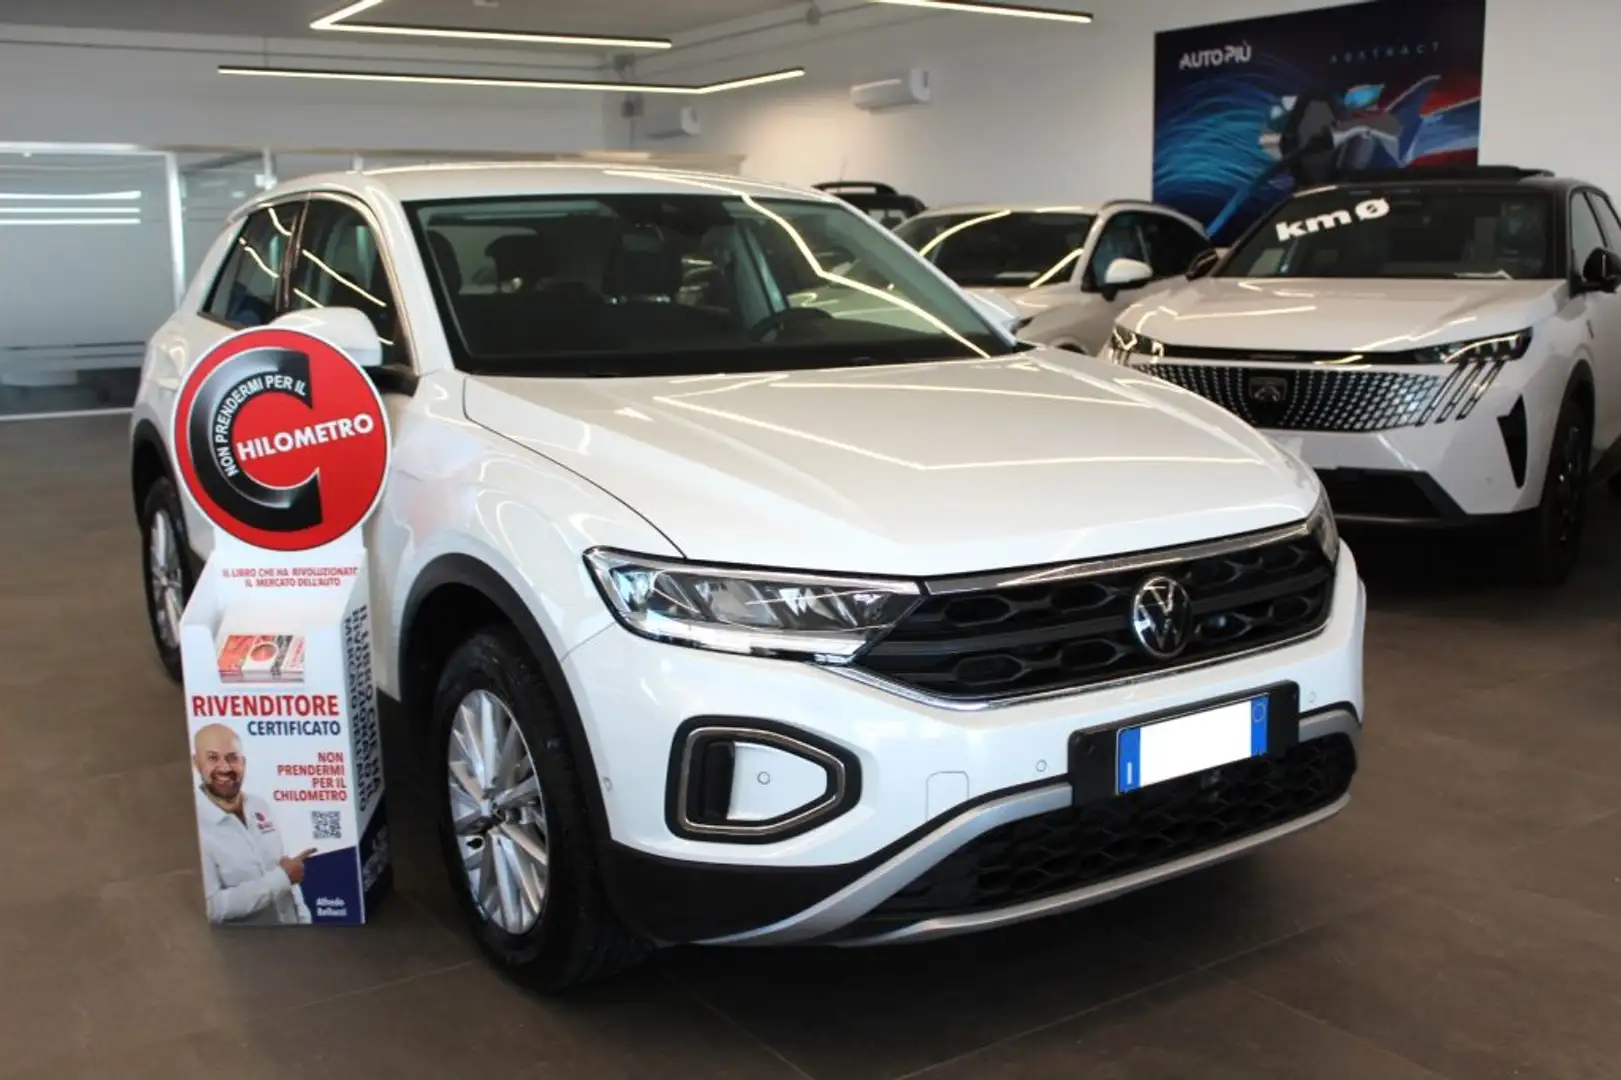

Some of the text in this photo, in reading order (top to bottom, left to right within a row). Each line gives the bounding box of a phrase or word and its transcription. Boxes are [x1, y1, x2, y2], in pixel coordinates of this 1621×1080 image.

[1275, 209, 1352, 242] km
[215, 374, 307, 477] NON PRENDERMI PER IL
[231, 568, 257, 578] LIBRO
[258, 567, 275, 577] CHE
[276, 567, 290, 577] HA
[244, 578, 254, 588] IL
[255, 578, 296, 588] MERCATO
[192, 695, 341, 716] RIVENDITORE
[247, 720, 341, 736] CERTIFICATO
[318, 751, 344, 763] NON
[277, 764, 345, 776] PRENDERMI
[312, 777, 347, 789] PER IL
[273, 789, 348, 802] CHILOMETRO
